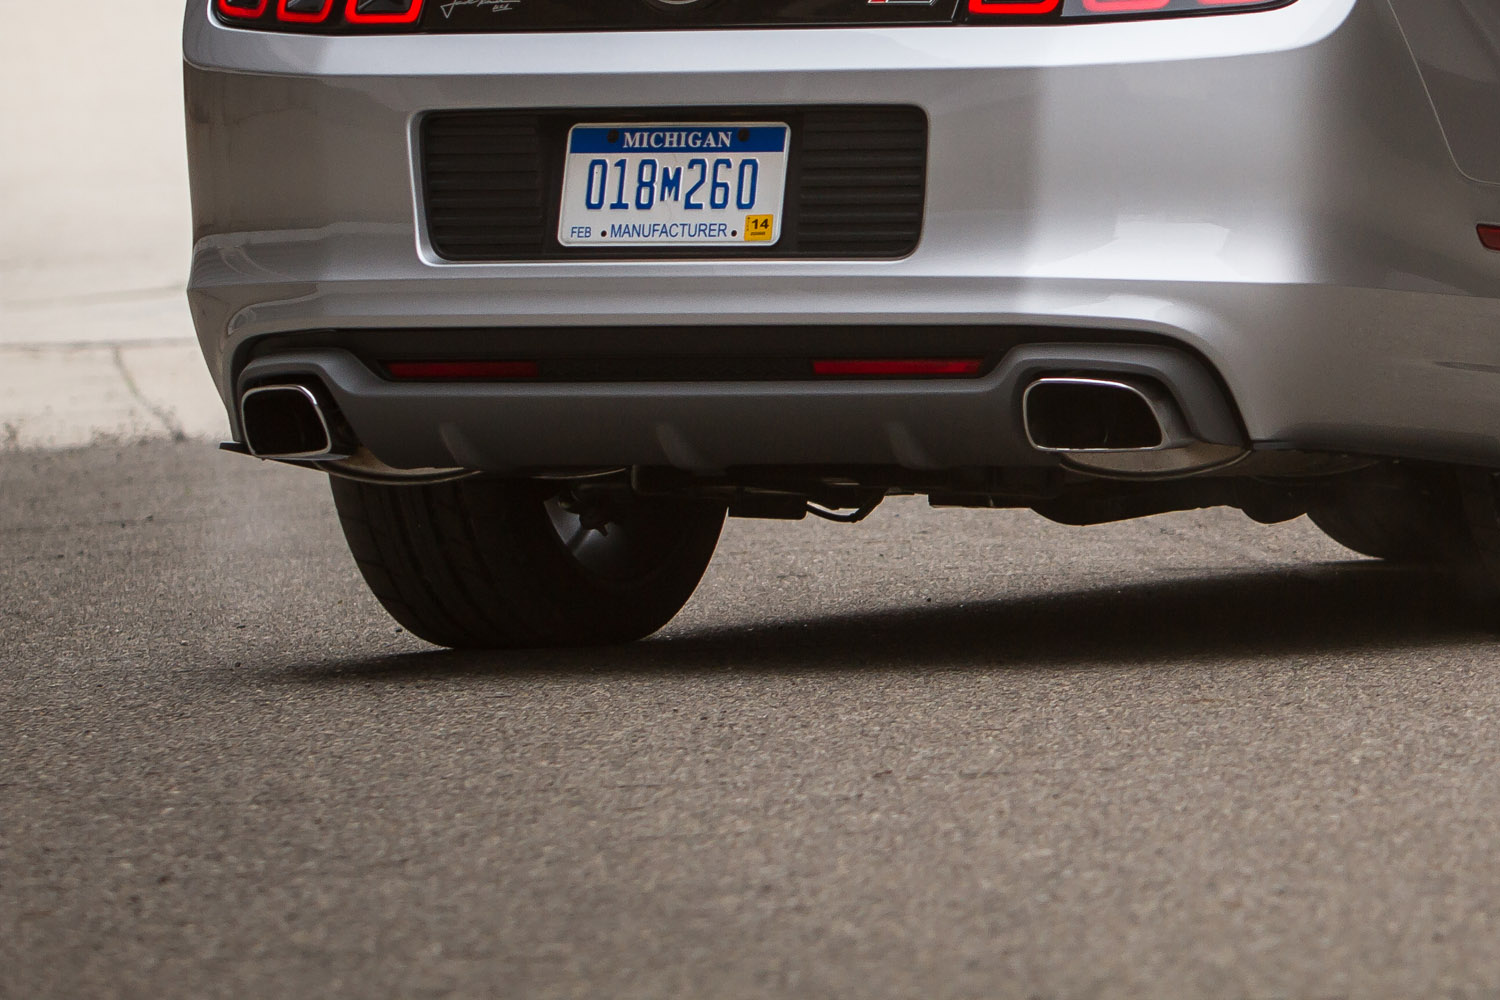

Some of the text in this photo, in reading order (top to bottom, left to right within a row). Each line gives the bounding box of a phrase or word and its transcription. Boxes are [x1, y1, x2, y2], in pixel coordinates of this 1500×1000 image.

[622, 131, 733, 148] MICHIGAN
[585, 158, 760, 210] 018M260
[570, 223, 728, 239] FEB MANUFACTURER
[751, 218, 770, 230] 14
